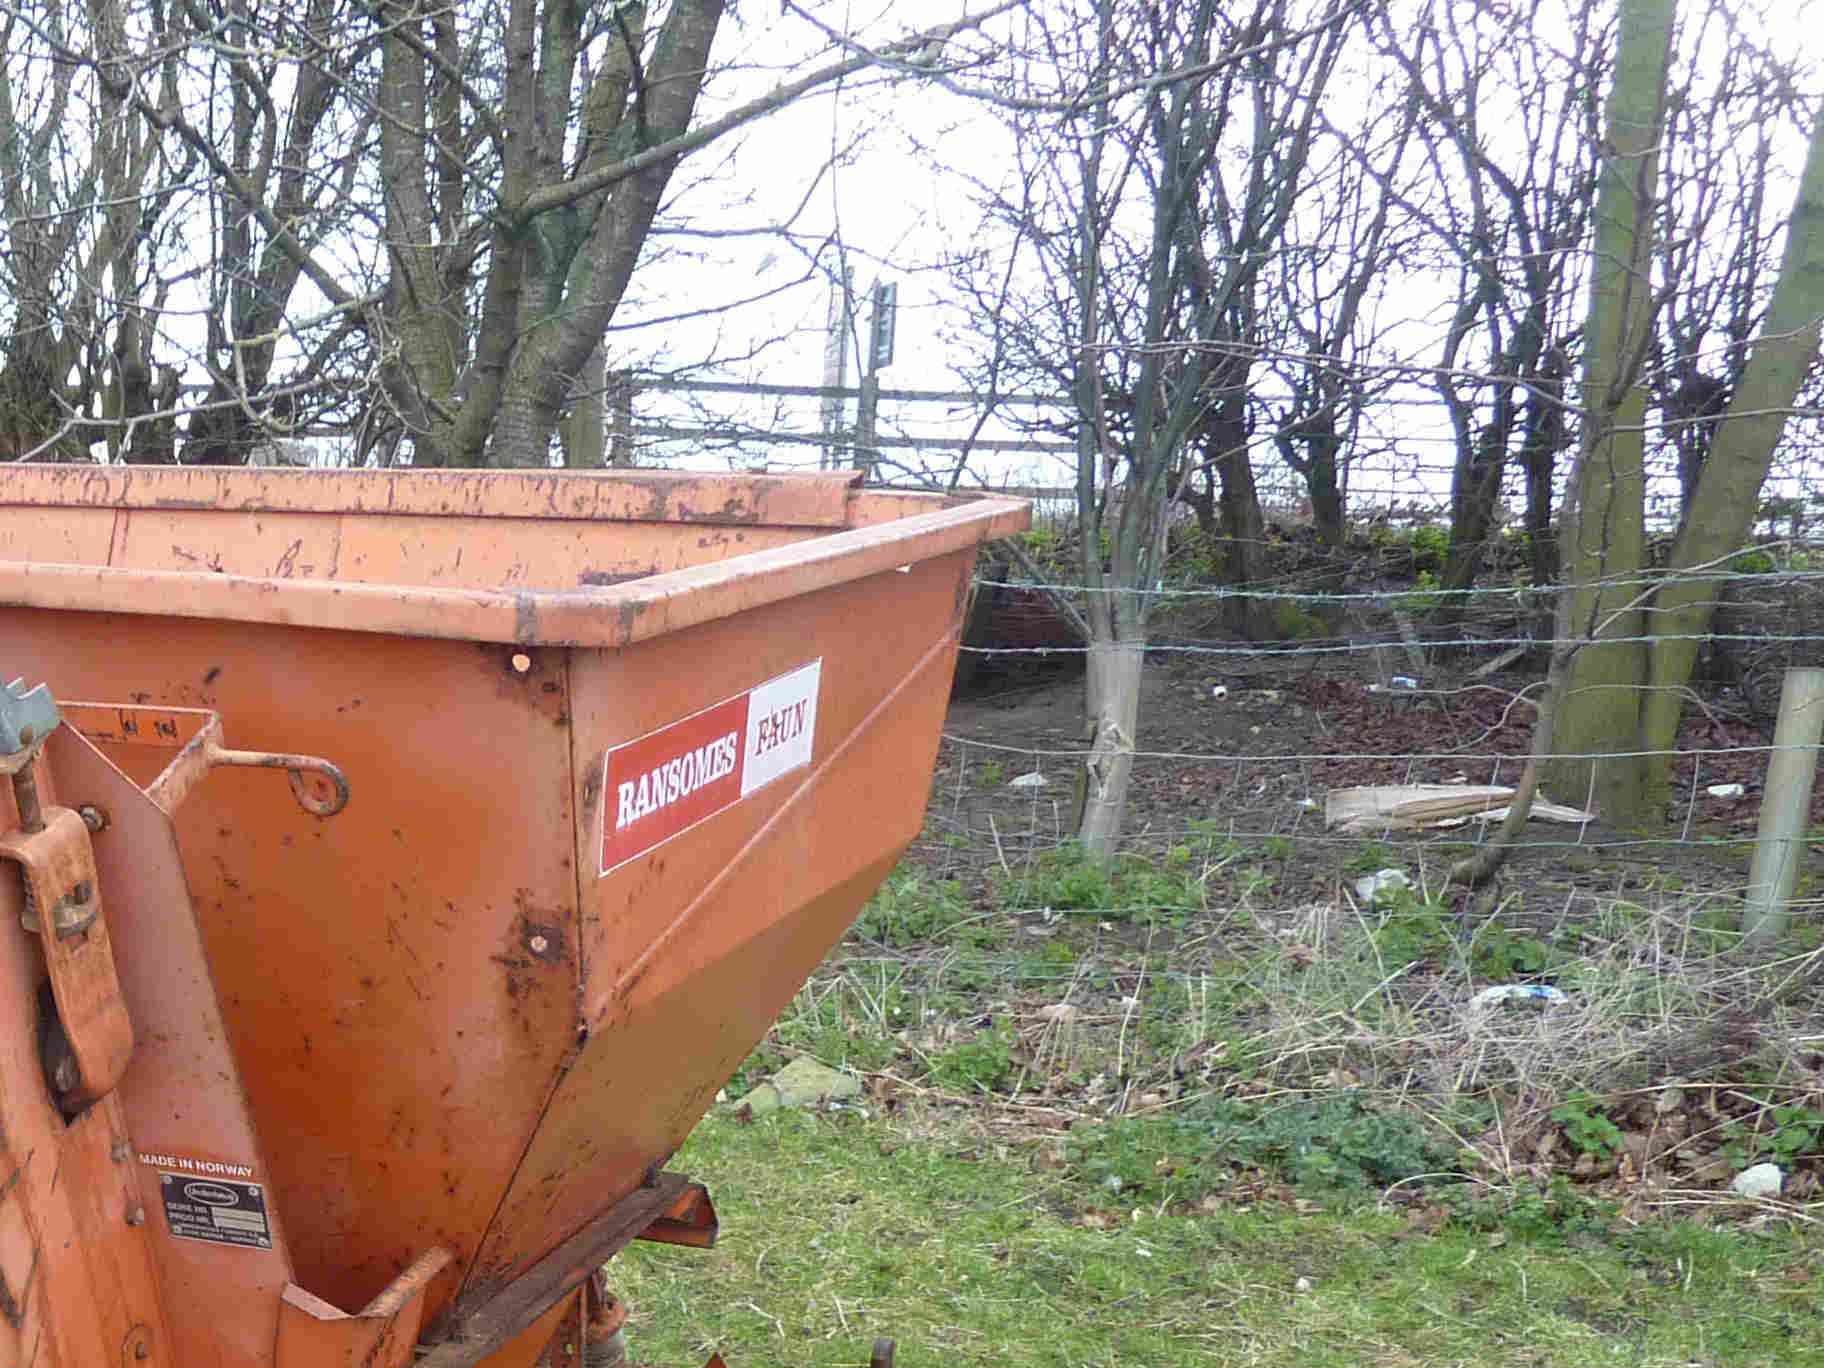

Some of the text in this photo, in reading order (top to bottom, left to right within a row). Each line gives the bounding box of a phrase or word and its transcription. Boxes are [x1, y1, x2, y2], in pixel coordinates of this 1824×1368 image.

[616, 698, 808, 829] RANSOMES FAUN
[139, 1153, 253, 1177] MADE IN NORWAY
